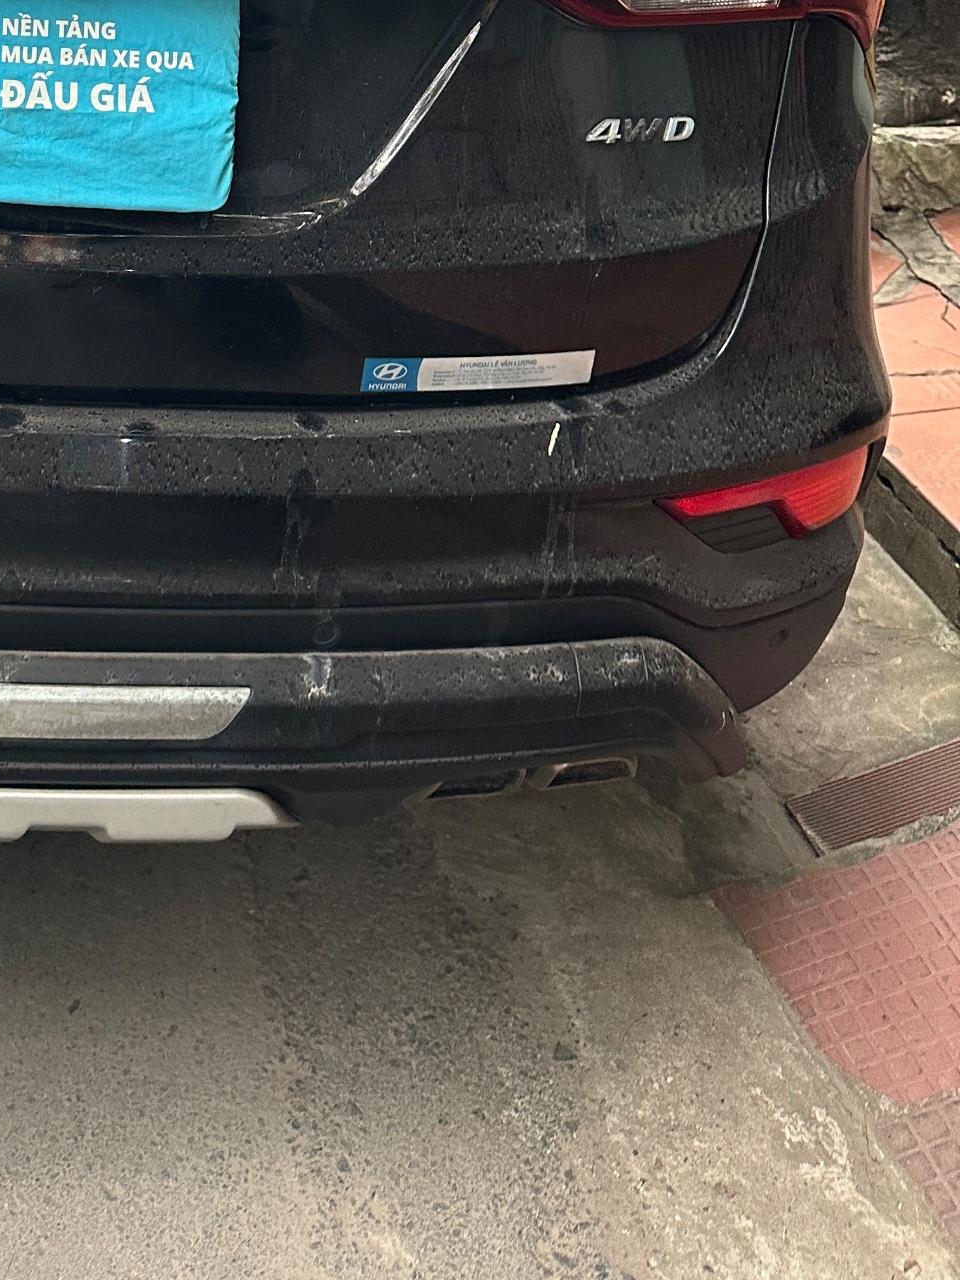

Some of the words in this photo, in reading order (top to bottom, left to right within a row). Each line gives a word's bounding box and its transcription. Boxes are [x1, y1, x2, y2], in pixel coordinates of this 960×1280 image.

[2, 12, 50, 37] NỀN
[56, 14, 116, 39] TẢNG
[1, 45, 53, 65] MUA
[60, 44, 107, 67] BÁN
[112, 50, 140, 69] XE
[146, 51, 194, 72] QUA
[0, 71, 79, 111] ĐẤU
[90, 76, 156, 113] GIÁ
[585, 116, 696, 144] 4WD
[368, 382, 407, 390] HYUNDAI
